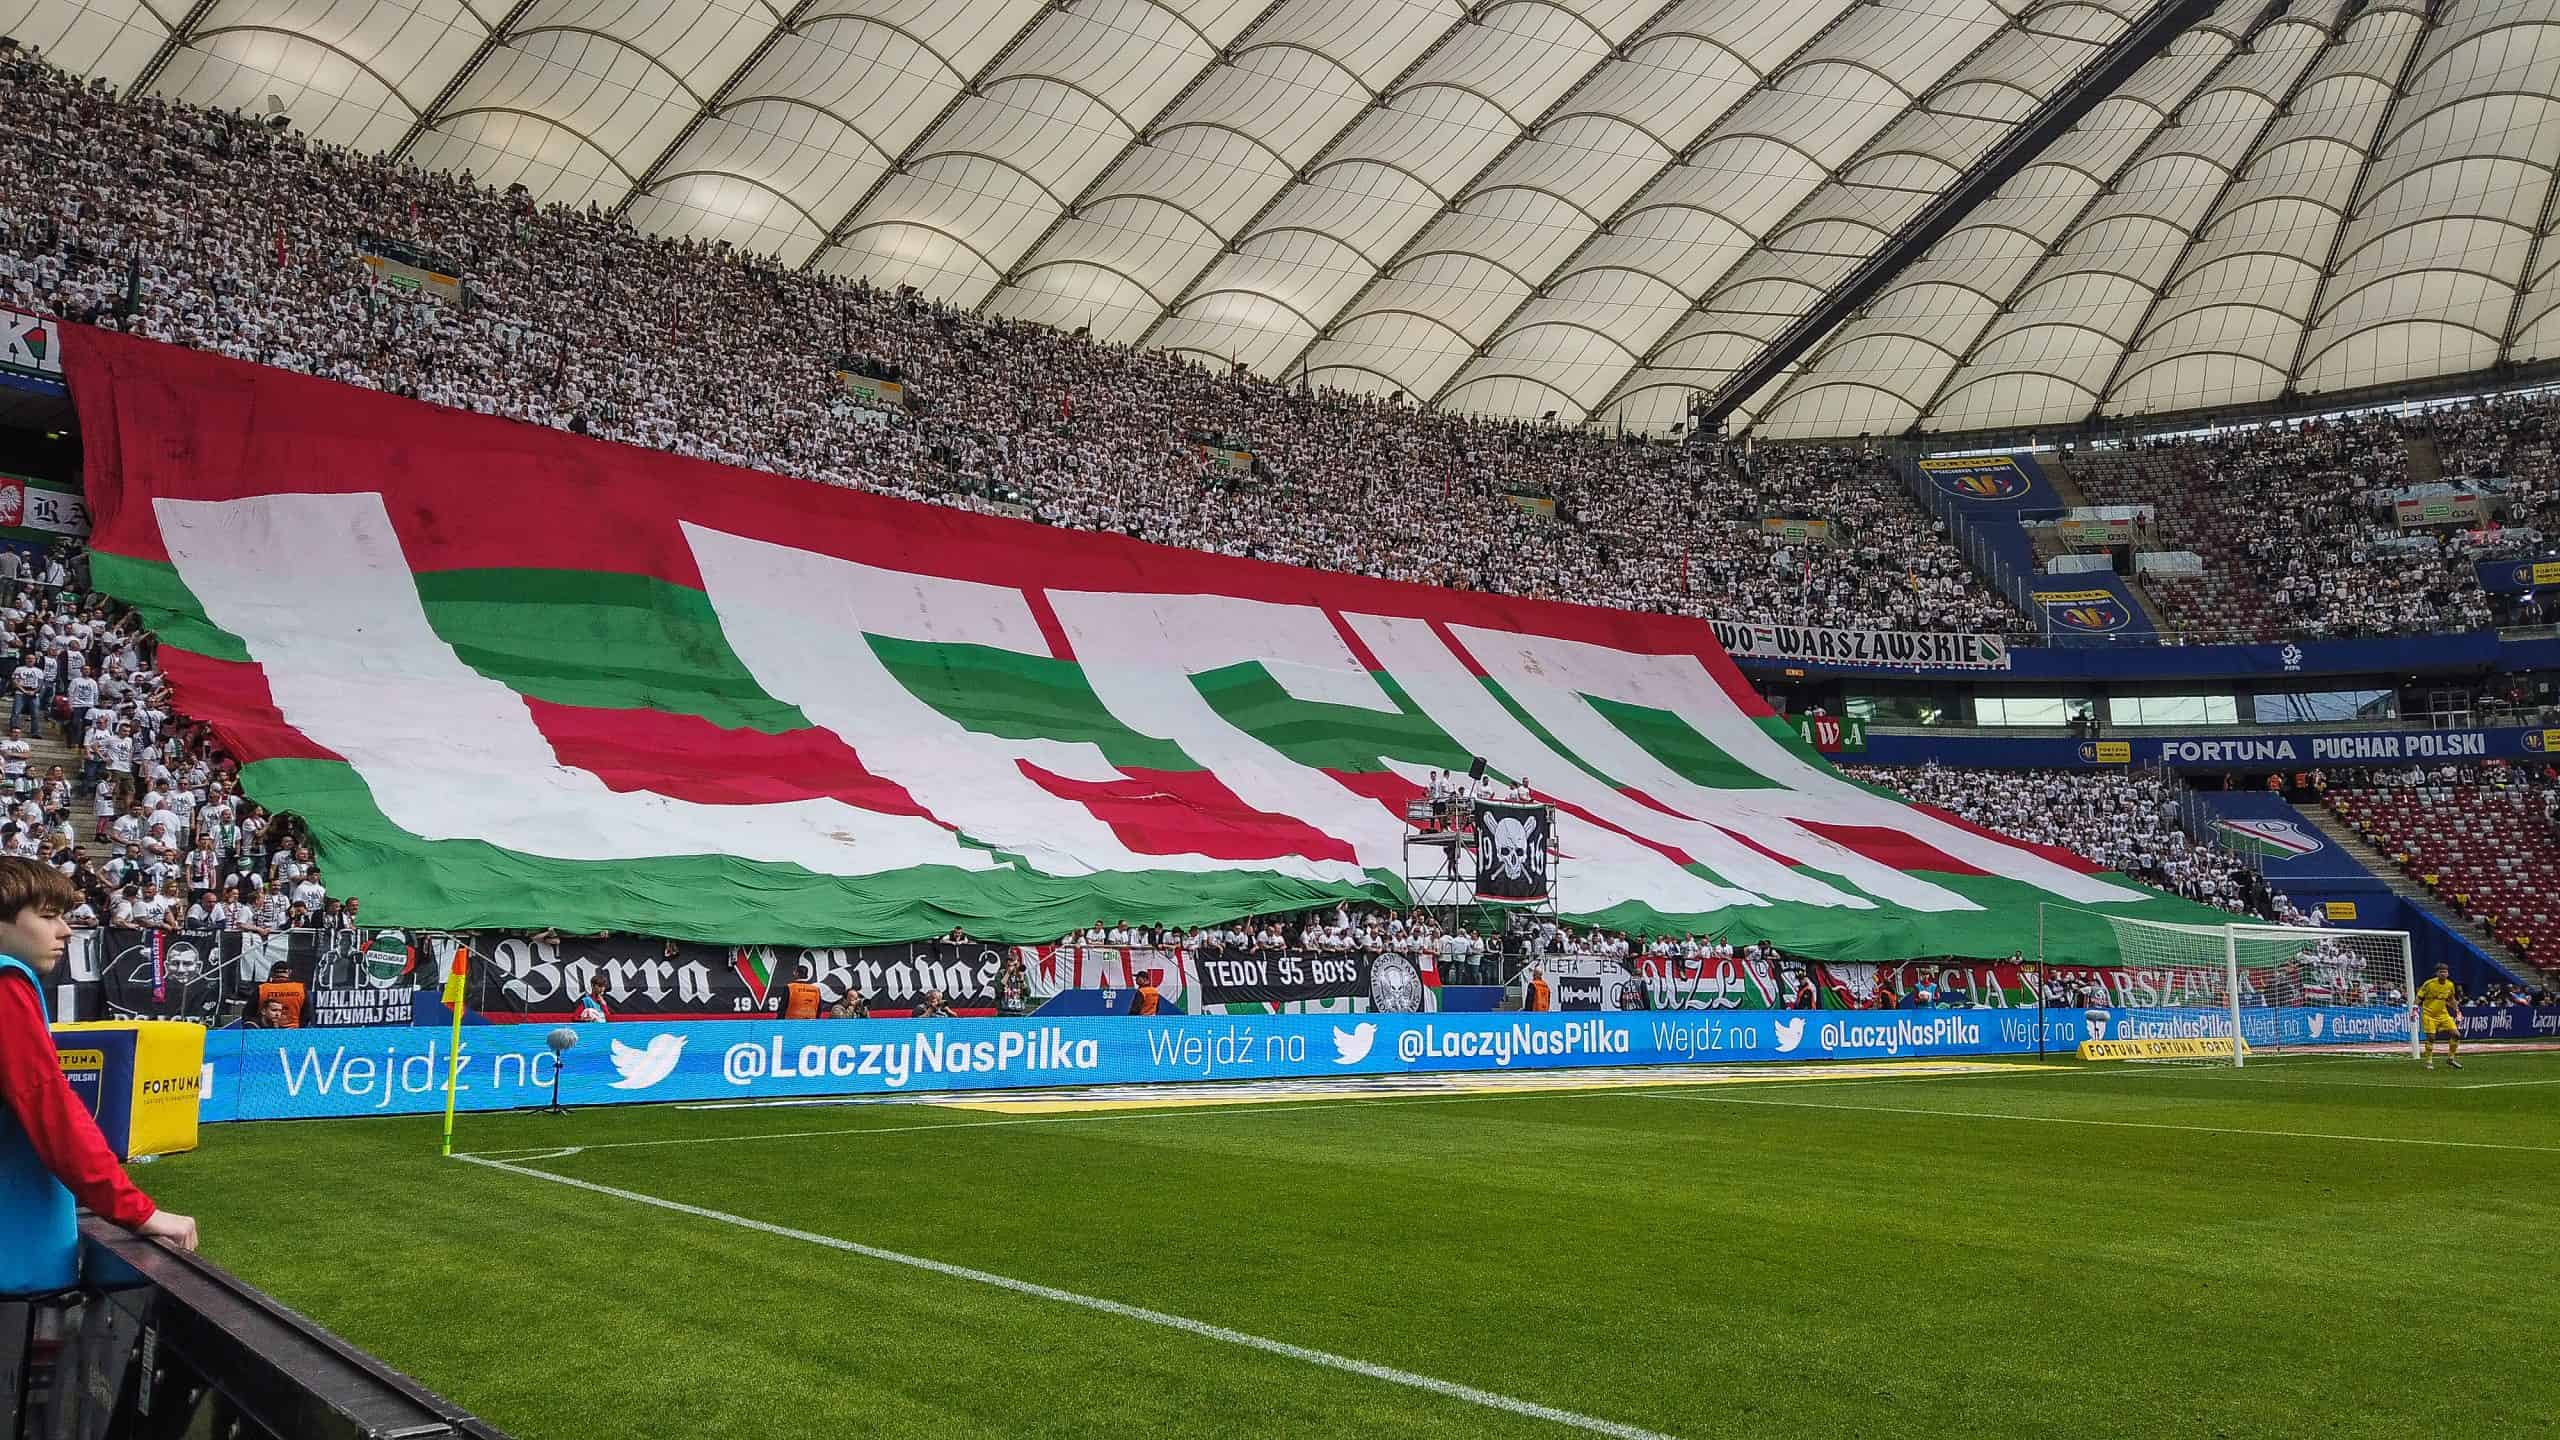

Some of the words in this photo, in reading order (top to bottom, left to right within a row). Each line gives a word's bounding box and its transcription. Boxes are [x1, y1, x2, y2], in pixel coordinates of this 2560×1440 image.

[1775, 627, 1978, 662] WARSZAWSKIE
[153, 490, 2150, 912] LEGIA
[2162, 740, 2296, 761] FORTUNA
[2312, 737, 2400, 760] PUCHAR
[2405, 733, 2486, 757] POLSKI
[495, 939, 715, 1004] Barra
[1204, 960, 1269, 988] TEDDY
[1278, 957, 1304, 985] 95
[1312, 959, 1357, 985] BOYS
[316, 991, 376, 1008] MALINA
[379, 988, 412, 1007] PDW
[767, 996, 782, 1010] 9
[316, 1008, 383, 1025] TRZYMAJ
[1651, 1018, 1722, 1060] Wejdź
[1730, 1025, 1757, 1050] na
[1820, 1015, 1980, 1055] @LaczyNasPilka
[2055, 1022, 2075, 1042] na
[723, 1027, 1098, 1086] @LaczyNasPilka
[1147, 1024, 1253, 1076] Wejdź
[1265, 1034, 1305, 1063] na
[1398, 1020, 1629, 1066] @LaczyNasPilka
[2088, 1044, 2142, 1057] FORTUNA
[2148, 1042, 2197, 1055] FORTUNA
[67, 1073, 97, 1082] POLSKI
[143, 1076, 200, 1095] FORTUNA
